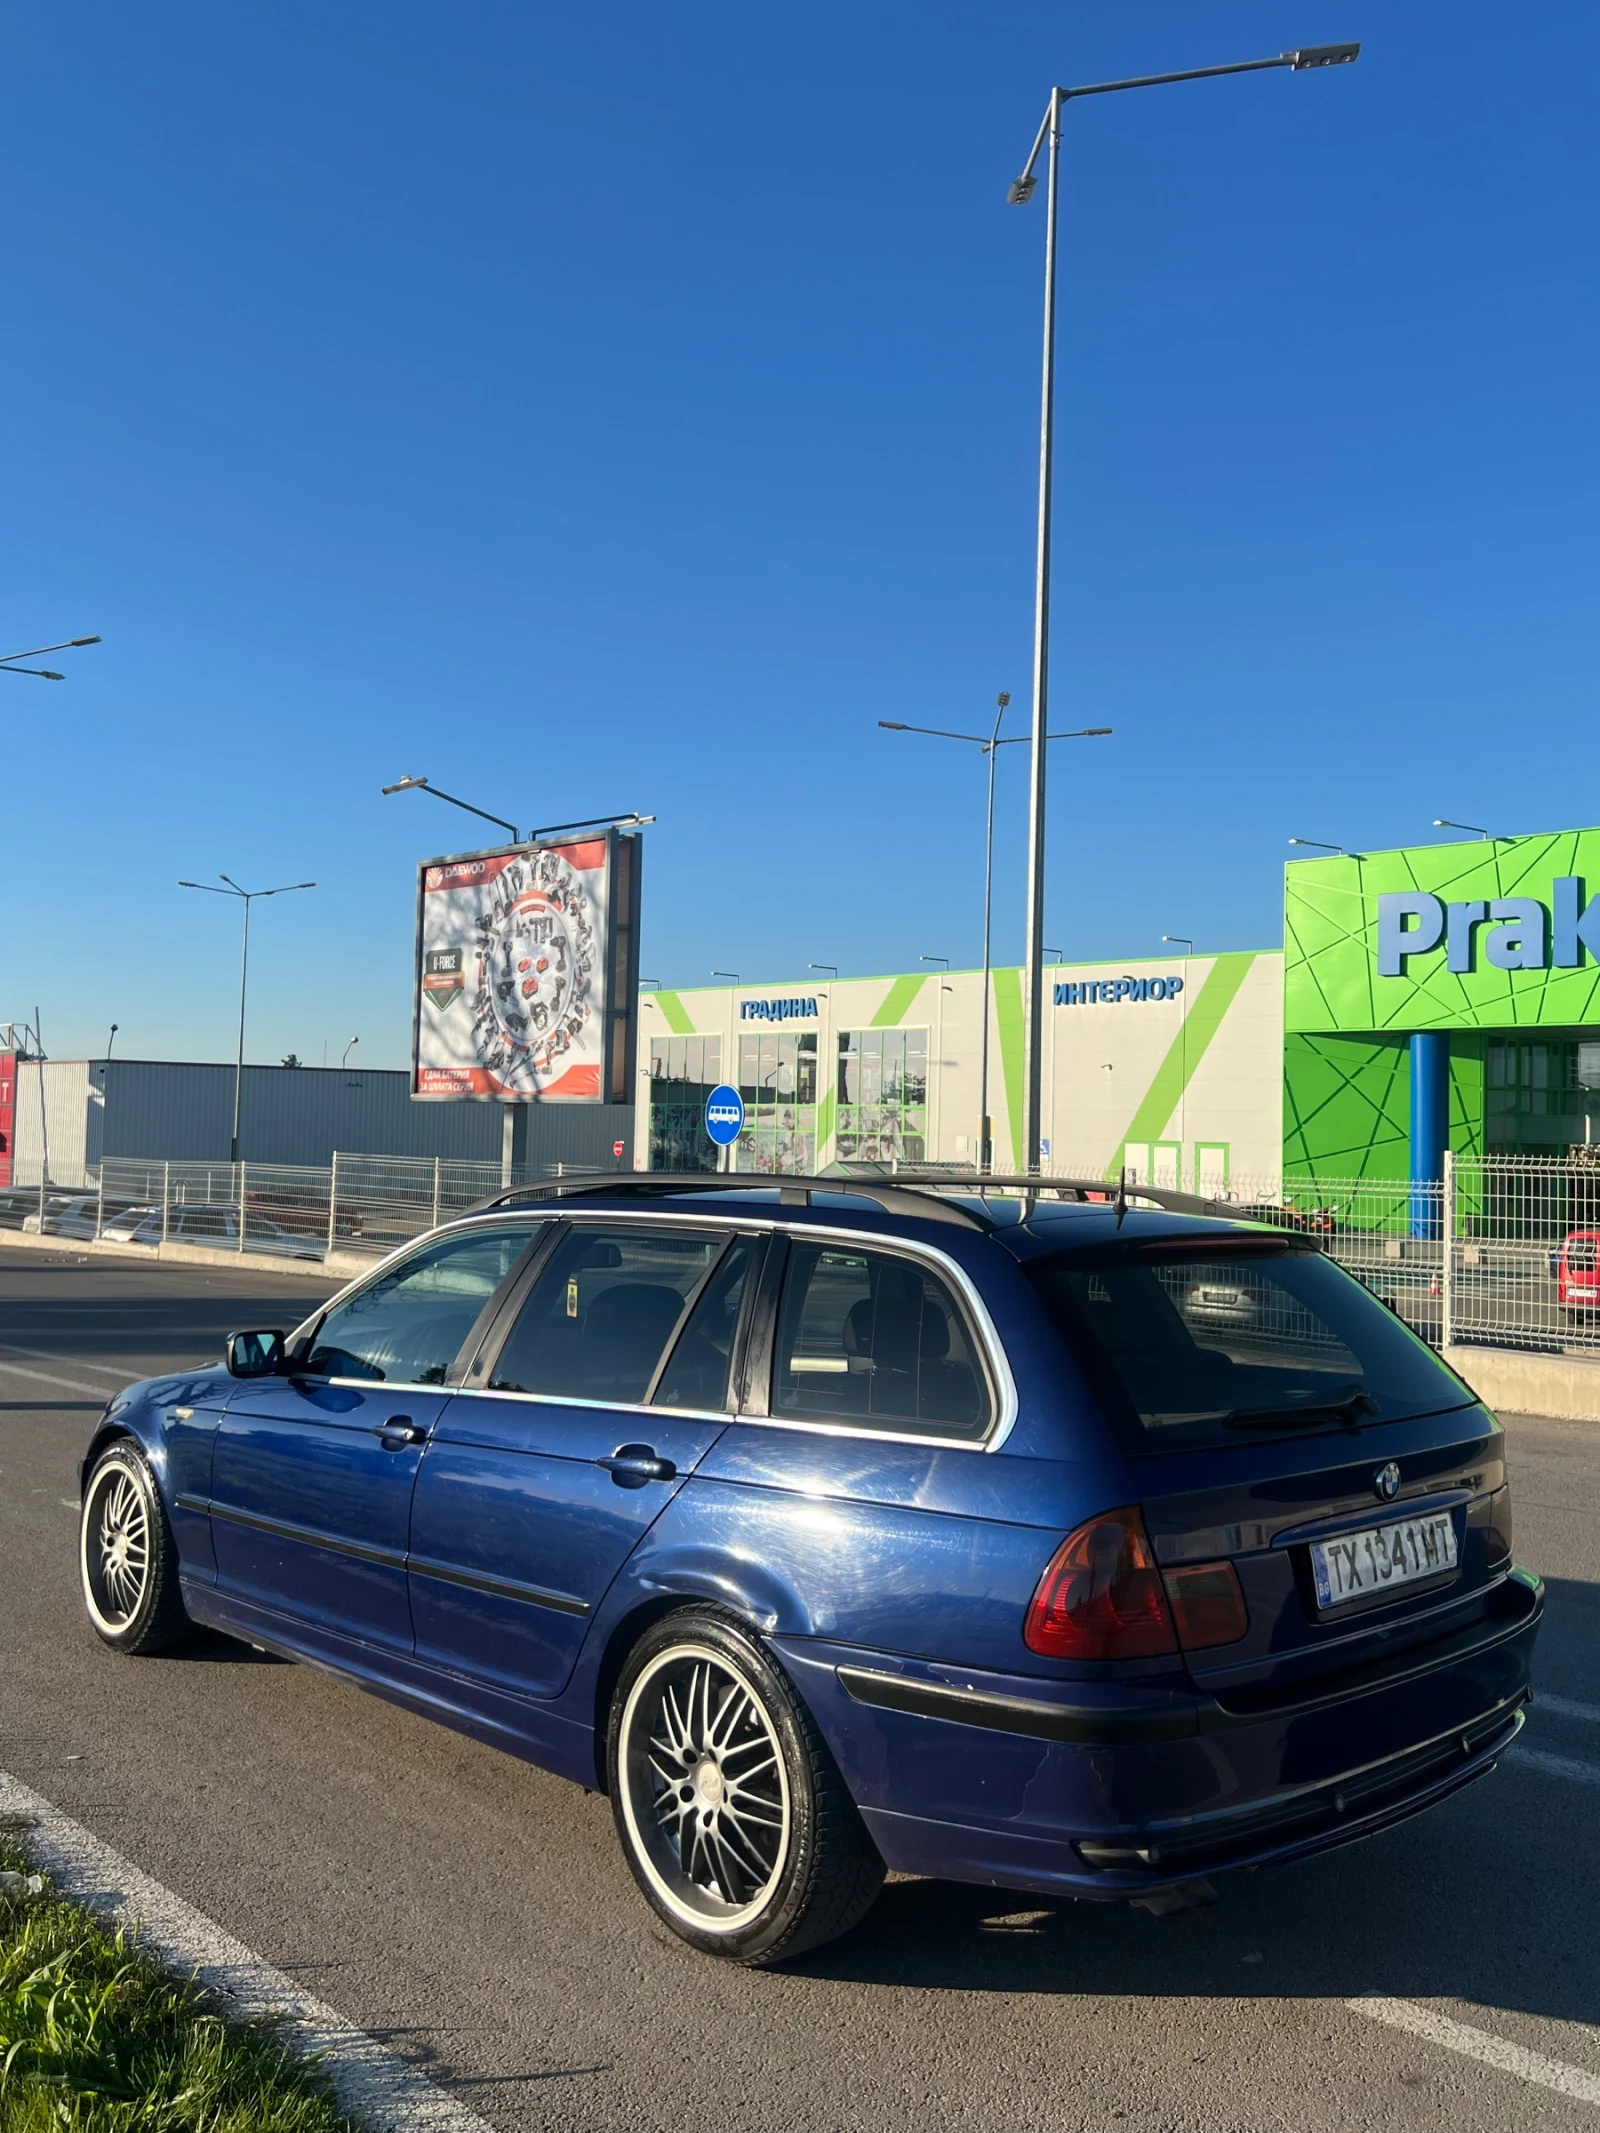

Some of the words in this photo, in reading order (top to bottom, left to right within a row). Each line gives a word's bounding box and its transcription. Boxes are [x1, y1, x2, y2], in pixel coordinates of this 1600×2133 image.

[445, 862, 485, 877] DAEWOO
[1378, 876, 1600, 977] Prak
[433, 954, 456, 970] U-FORCE
[1053, 976, 1184, 1006] ИНТЕРИОР
[740, 998, 818, 1022] ГРАДИНА
[424, 1070, 441, 1080] ЕДНА
[442, 1069, 470, 1079] БАТЕРИЯ
[1319, 1582, 1331, 1597] BG
